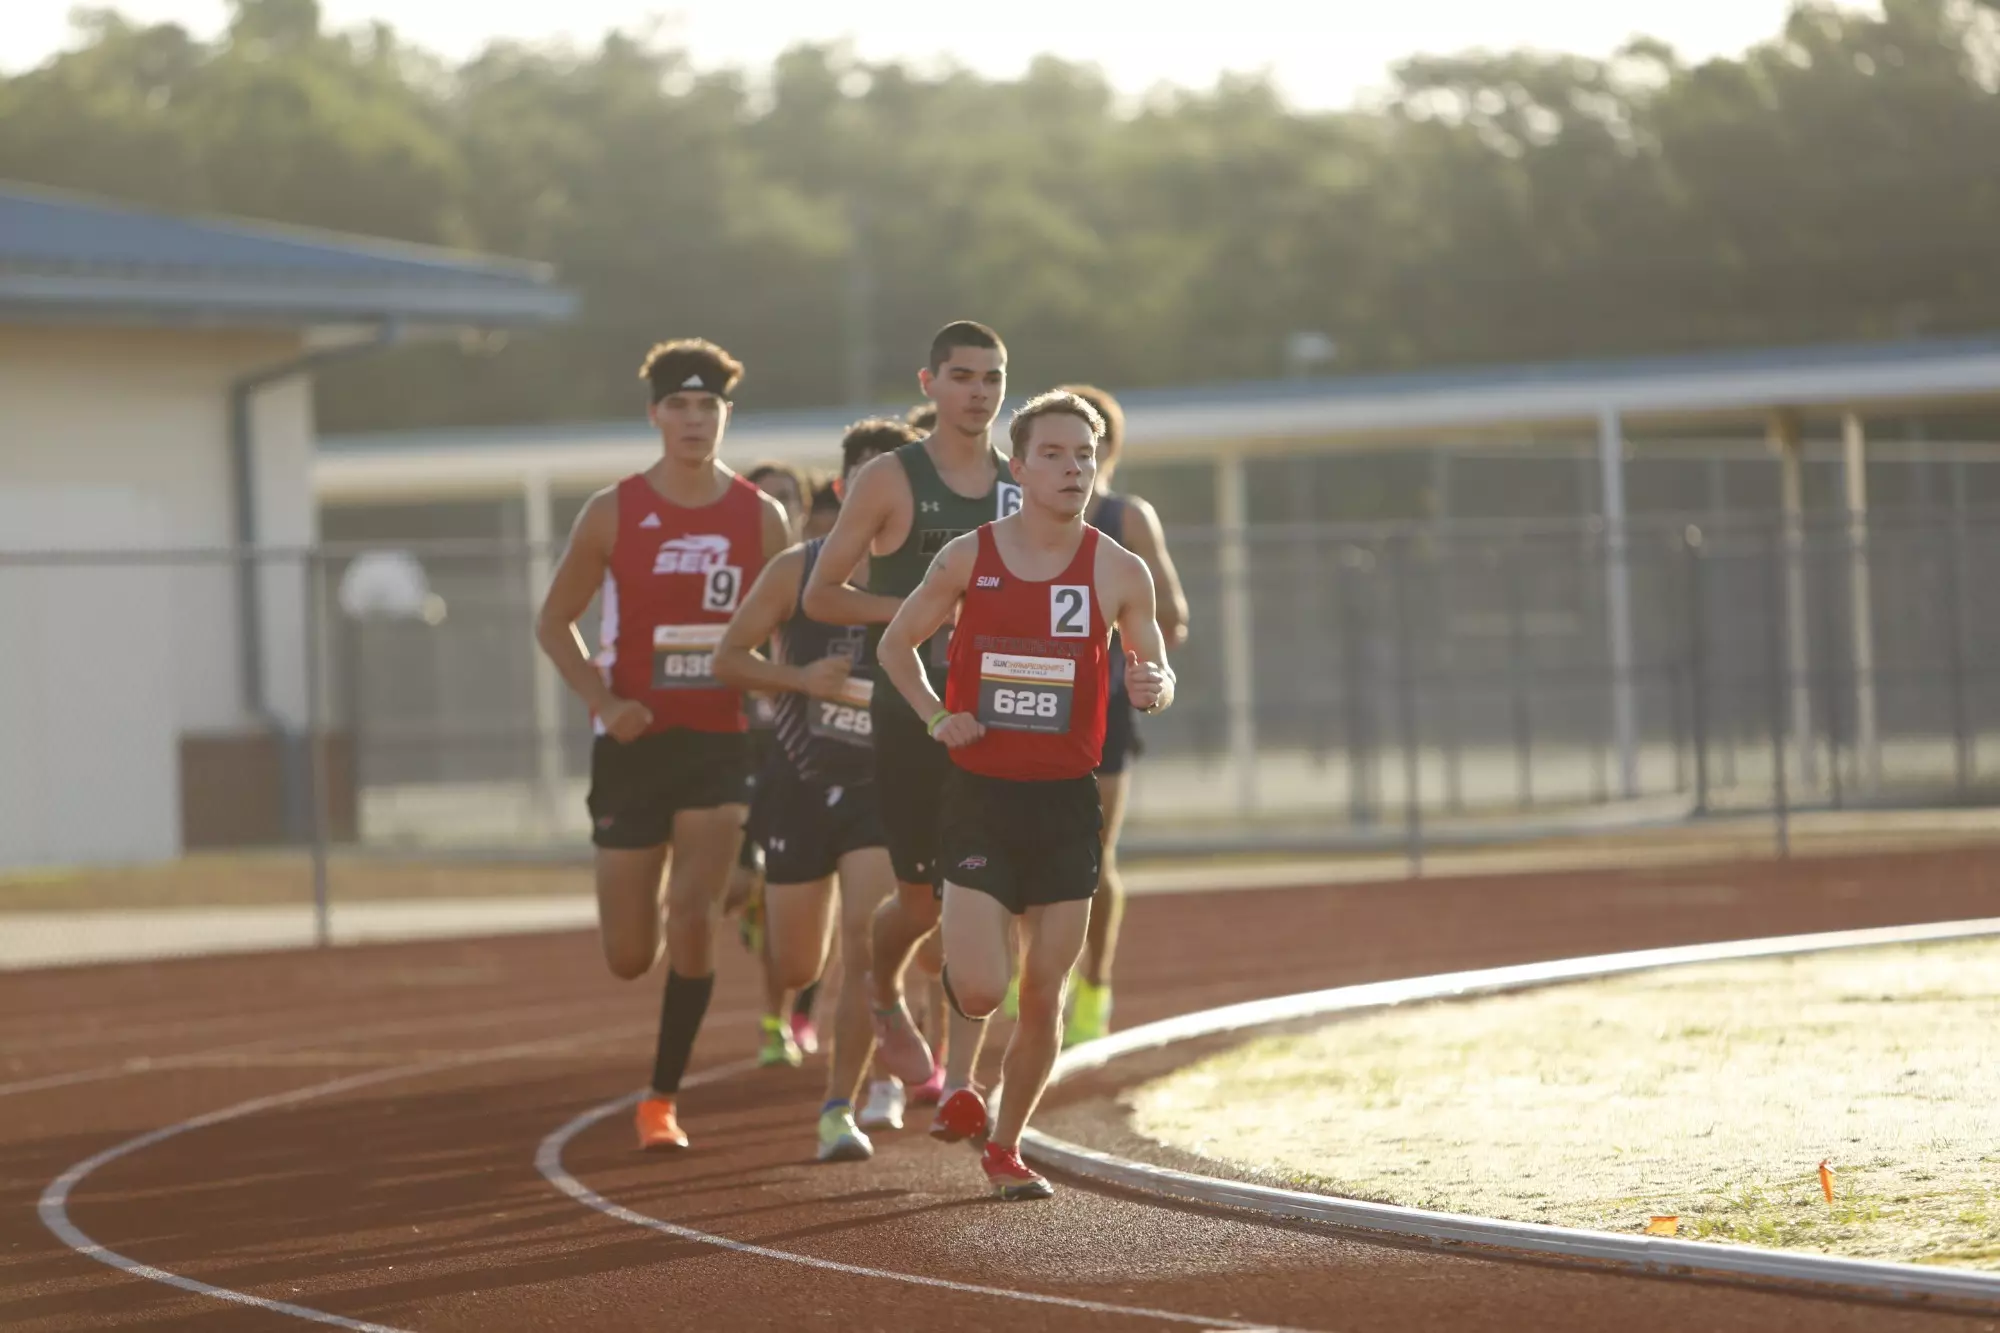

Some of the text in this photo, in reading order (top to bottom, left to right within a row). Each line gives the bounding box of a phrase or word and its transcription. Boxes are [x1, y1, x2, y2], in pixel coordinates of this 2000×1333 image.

[710, 570, 734, 607] 9
[976, 576, 1000, 587] SUN
[1054, 588, 1083, 633] 2
[820, 701, 872, 736] 729
[993, 688, 1058, 717] 628
